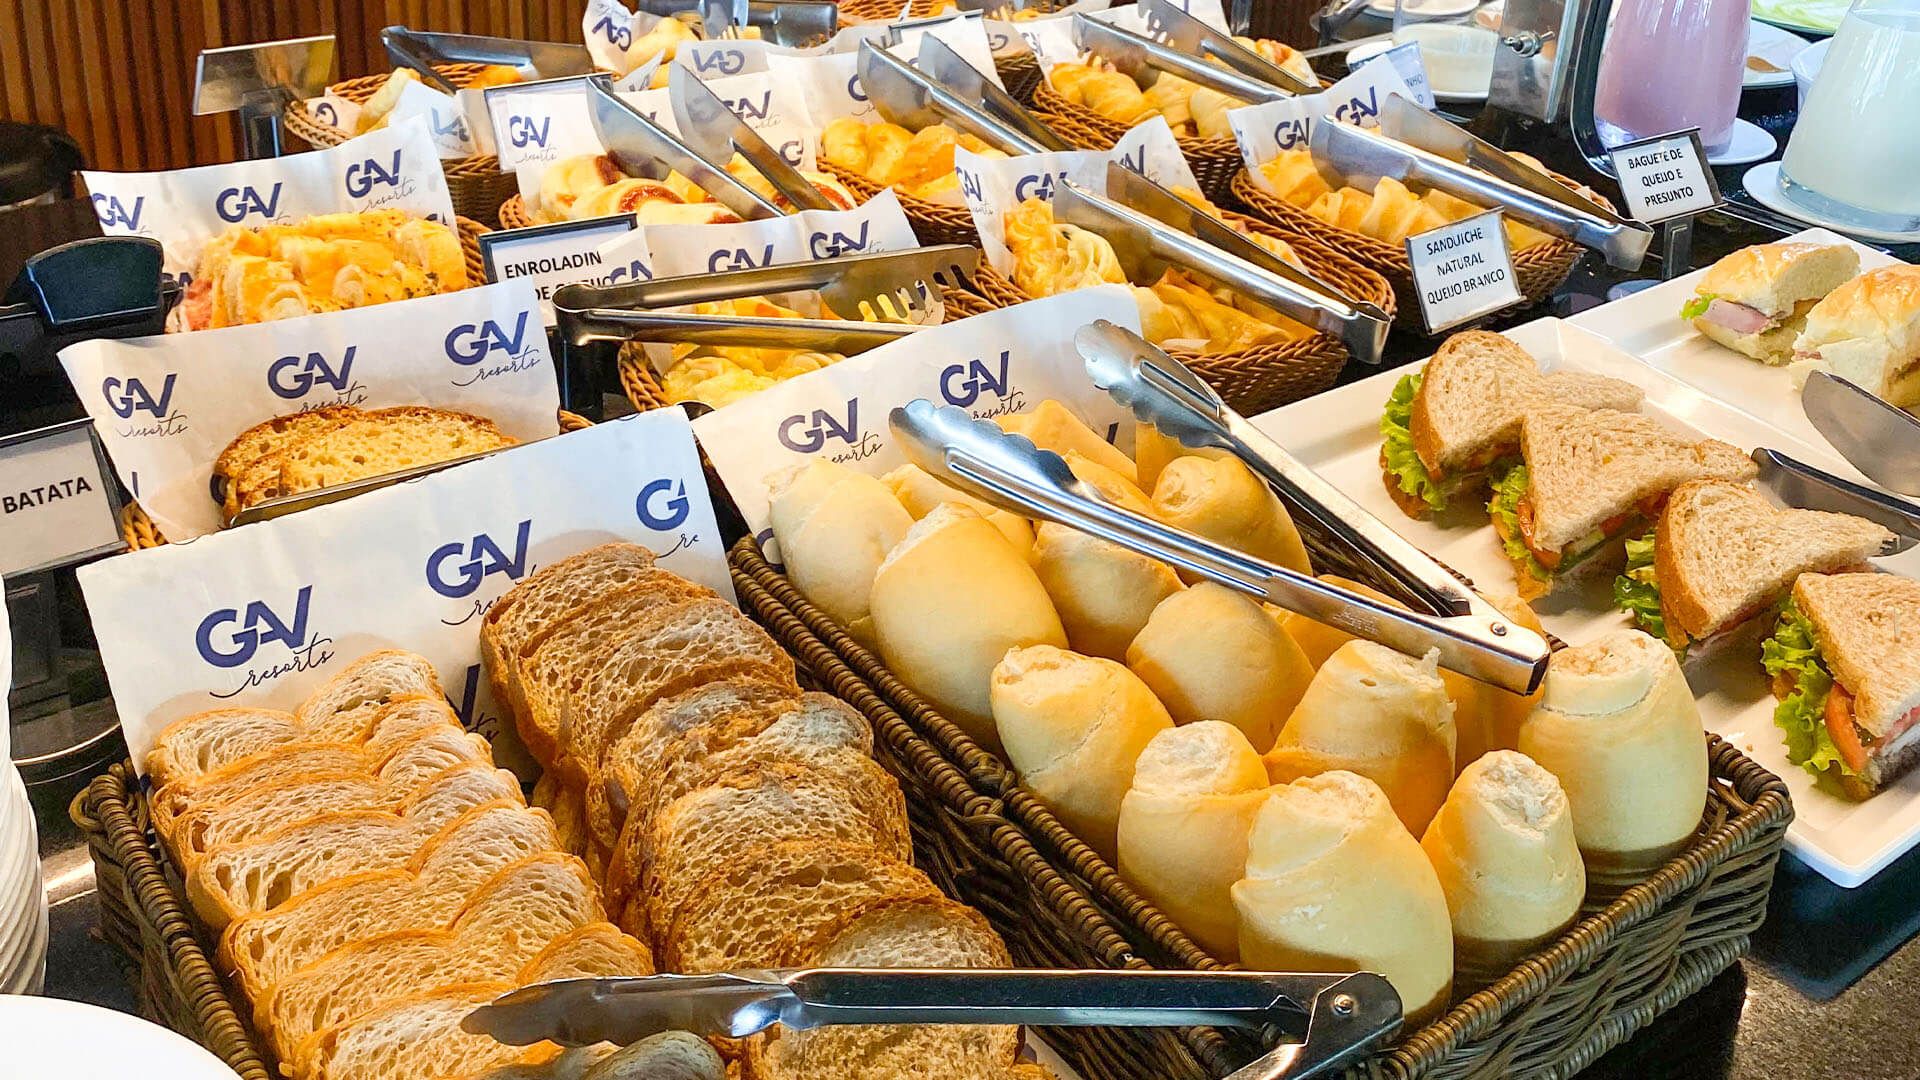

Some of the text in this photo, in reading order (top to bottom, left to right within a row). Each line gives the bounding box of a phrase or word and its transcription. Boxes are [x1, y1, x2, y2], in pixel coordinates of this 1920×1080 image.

[509, 115, 551, 148] GAV
[346, 149, 402, 198] GAV
[1627, 148, 1683, 170] BAGUETE DE
[1641, 170, 1684, 187] QUEIJO E
[91, 187, 145, 230] GAV
[215, 182, 283, 223] GAV
[1644, 186, 1694, 207] PRESUNTO
[810, 219, 870, 260] GAV
[1426, 227, 1484, 256] SANDUICHE
[1436, 252, 1485, 277] NATURAL
[1427, 268, 1505, 305] QUEIJO BRANCO
[444, 311, 529, 366] GAV
[267, 345, 358, 400] GAV
[451, 345, 541, 387] resorts
[940, 350, 1010, 408] GAV
[102, 373, 177, 419] GAV
[114, 410, 188, 438] resorts
[778, 397, 858, 454] GAV
[2, 476, 93, 514] BATATA
[425, 519, 532, 599] GAV
[195, 584, 312, 669] GAV
[209, 631, 335, 698] resorts
